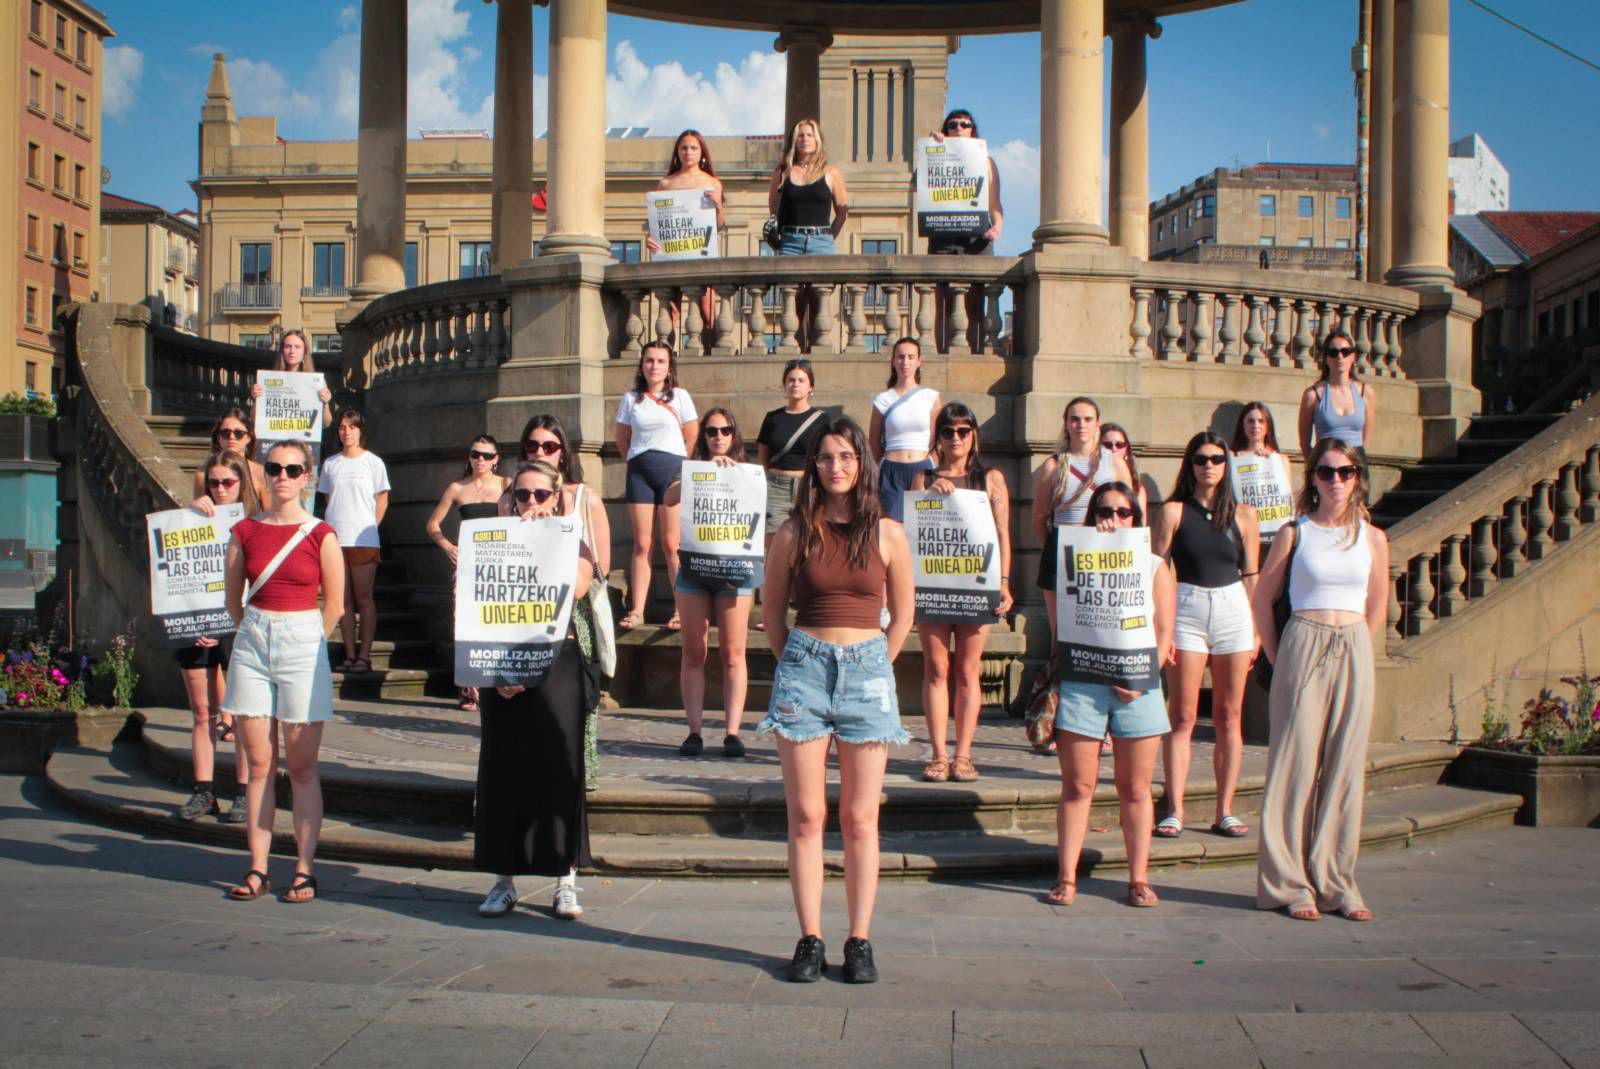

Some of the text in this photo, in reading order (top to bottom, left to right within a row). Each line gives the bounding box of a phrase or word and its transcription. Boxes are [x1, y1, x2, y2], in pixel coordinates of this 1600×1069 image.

[928, 166, 965, 177] KALEAK
[928, 177, 976, 188] HARTZEKO
[933, 189, 959, 201] UNEA
[658, 217, 693, 230] KALEAK
[659, 228, 706, 240] HARTZEKO
[664, 240, 690, 253] UNEA
[266, 398, 300, 409] KALEAK
[265, 409, 311, 419] HARTZEKO
[270, 419, 294, 430] UNEA
[1242, 484, 1279, 497] KALEAK
[693, 497, 738, 512] KALEAK
[693, 512, 752, 525] HARTZEKO
[1256, 508, 1277, 521] NEA
[164, 532, 179, 548] ES
[182, 525, 215, 544] HORA
[698, 527, 730, 541] UNEA
[918, 527, 968, 542] KALEAK
[166, 547, 181, 562] DE
[475, 550, 533, 558] MATXISTAREN
[918, 542, 985, 557] HARTZEKO
[690, 557, 754, 569] MOBILIZAZIOA
[925, 559, 960, 574] UNEA
[1076, 553, 1094, 570] ES
[1099, 551, 1133, 569] HORA
[167, 560, 223, 577] LAS CALL
[475, 565, 539, 584] KALEAK
[167, 576, 196, 584] CONTRA
[1077, 572, 1141, 589] DE TOMAR
[474, 584, 558, 602] HARTZEKO
[915, 592, 988, 604] MOBILIZAZIOA
[1076, 590, 1144, 607] LAS CALLES
[915, 601, 950, 609] UZTAILAK
[1075, 606, 1111, 614] CONTRA
[164, 611, 232, 627] MOVILIZACIÓ
[483, 604, 528, 624] UNEA
[1075, 613, 1120, 622] VIOLENCIA
[184, 624, 205, 632] JULIO
[1075, 620, 1119, 629] MACHISTA
[469, 649, 554, 660] MOBILIZAZIOA
[1071, 648, 1150, 665] MOVILIZACIÓN
[469, 660, 513, 669] UZTAILAK
[515, 661, 521, 669] 4
[1092, 663, 1116, 672] JULIO
[1122, 664, 1150, 673] IRUÑEA
